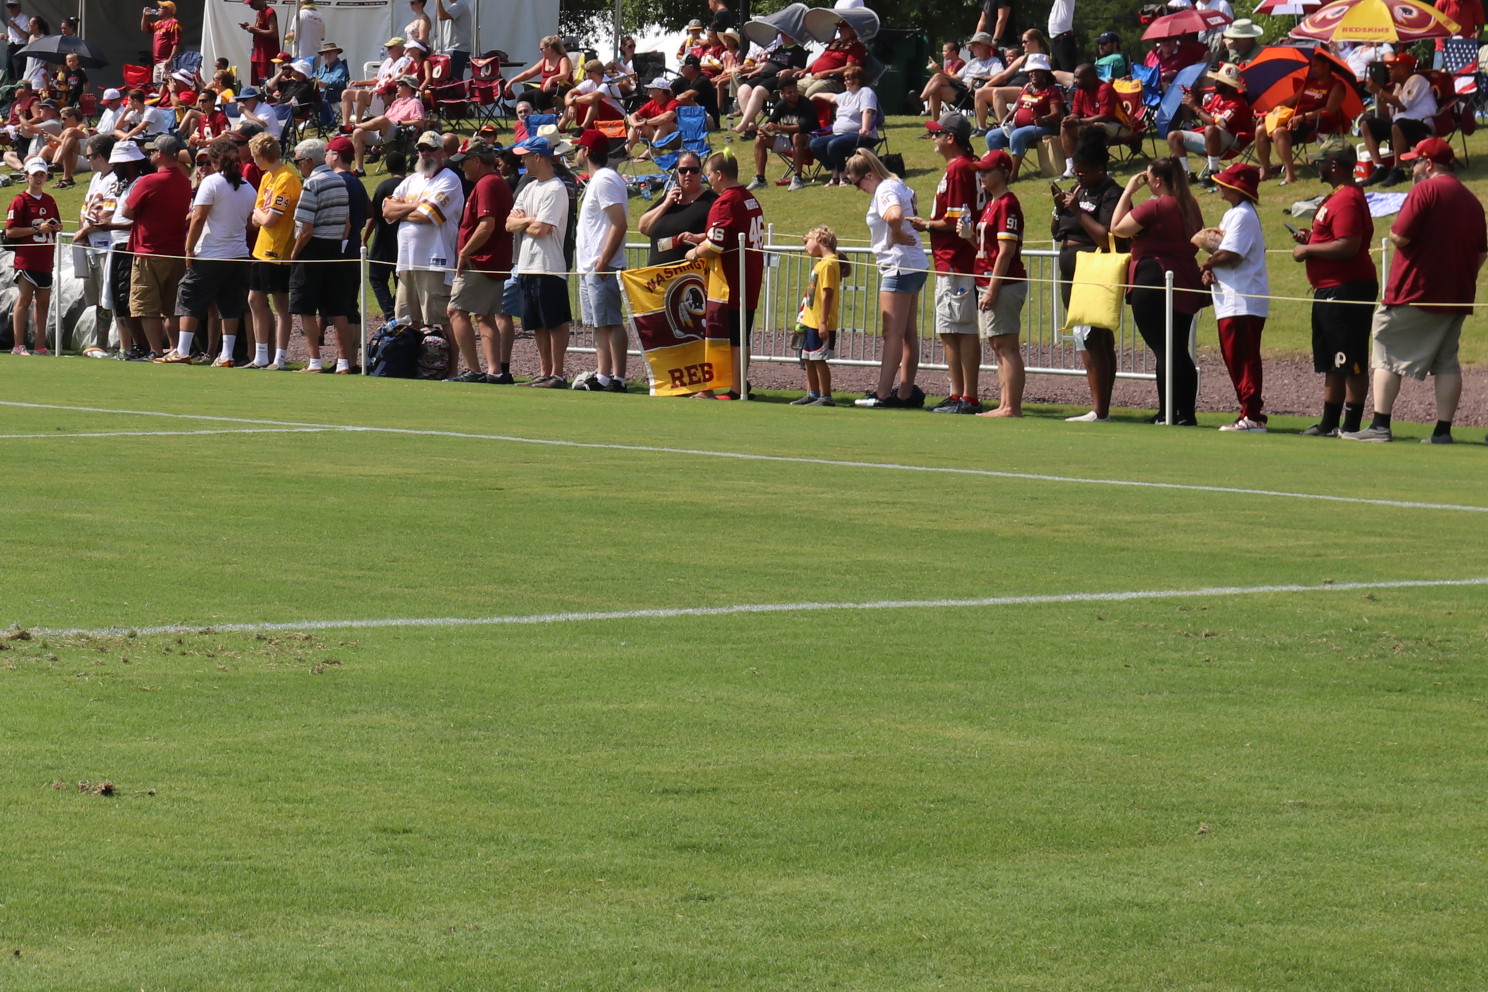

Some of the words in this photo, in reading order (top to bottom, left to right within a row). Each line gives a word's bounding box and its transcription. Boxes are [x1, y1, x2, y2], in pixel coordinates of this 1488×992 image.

[275, 195, 290, 208] 24
[1007, 217, 1018, 230] 91
[707, 227, 725, 240] 46
[748, 215, 765, 249] 46
[645, 258, 709, 293] WASHING
